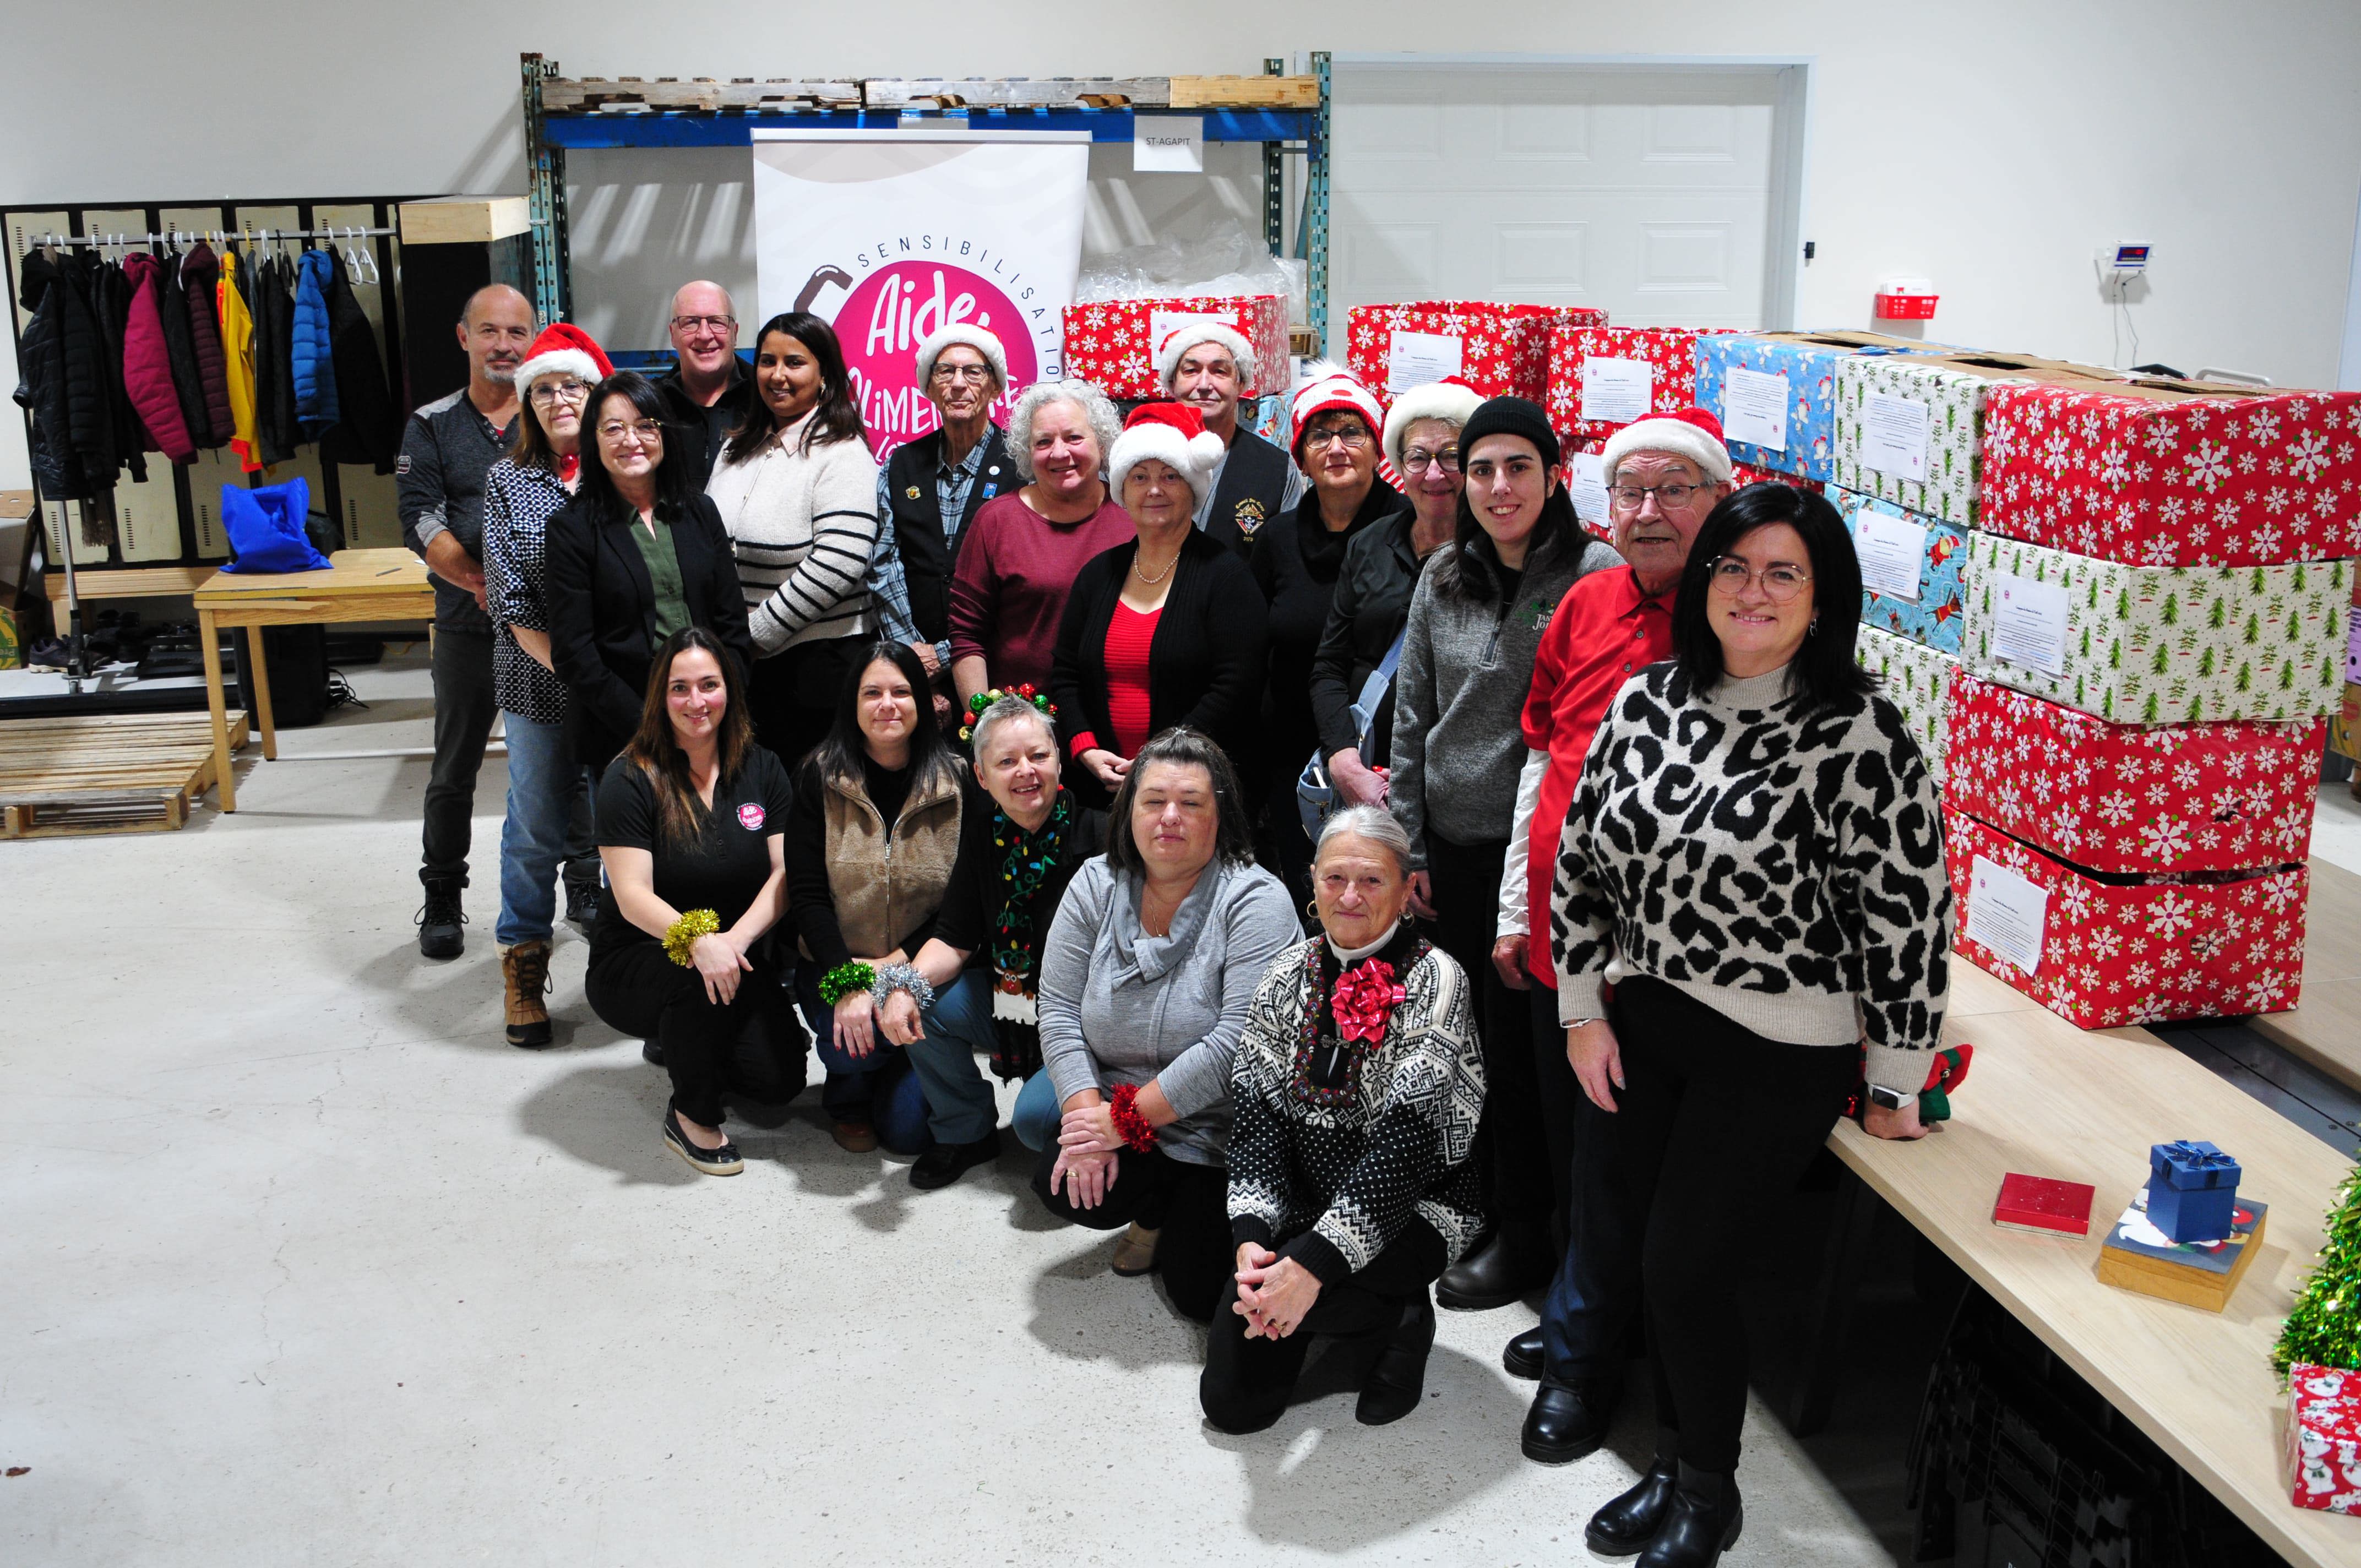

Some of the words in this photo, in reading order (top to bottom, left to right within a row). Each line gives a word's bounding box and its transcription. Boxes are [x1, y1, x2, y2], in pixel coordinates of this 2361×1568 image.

[1146, 137, 1190, 146] ST-AGAPIT
[858, 235, 1060, 375] SENSIBILISATIO
[866, 270, 990, 357] Aide
